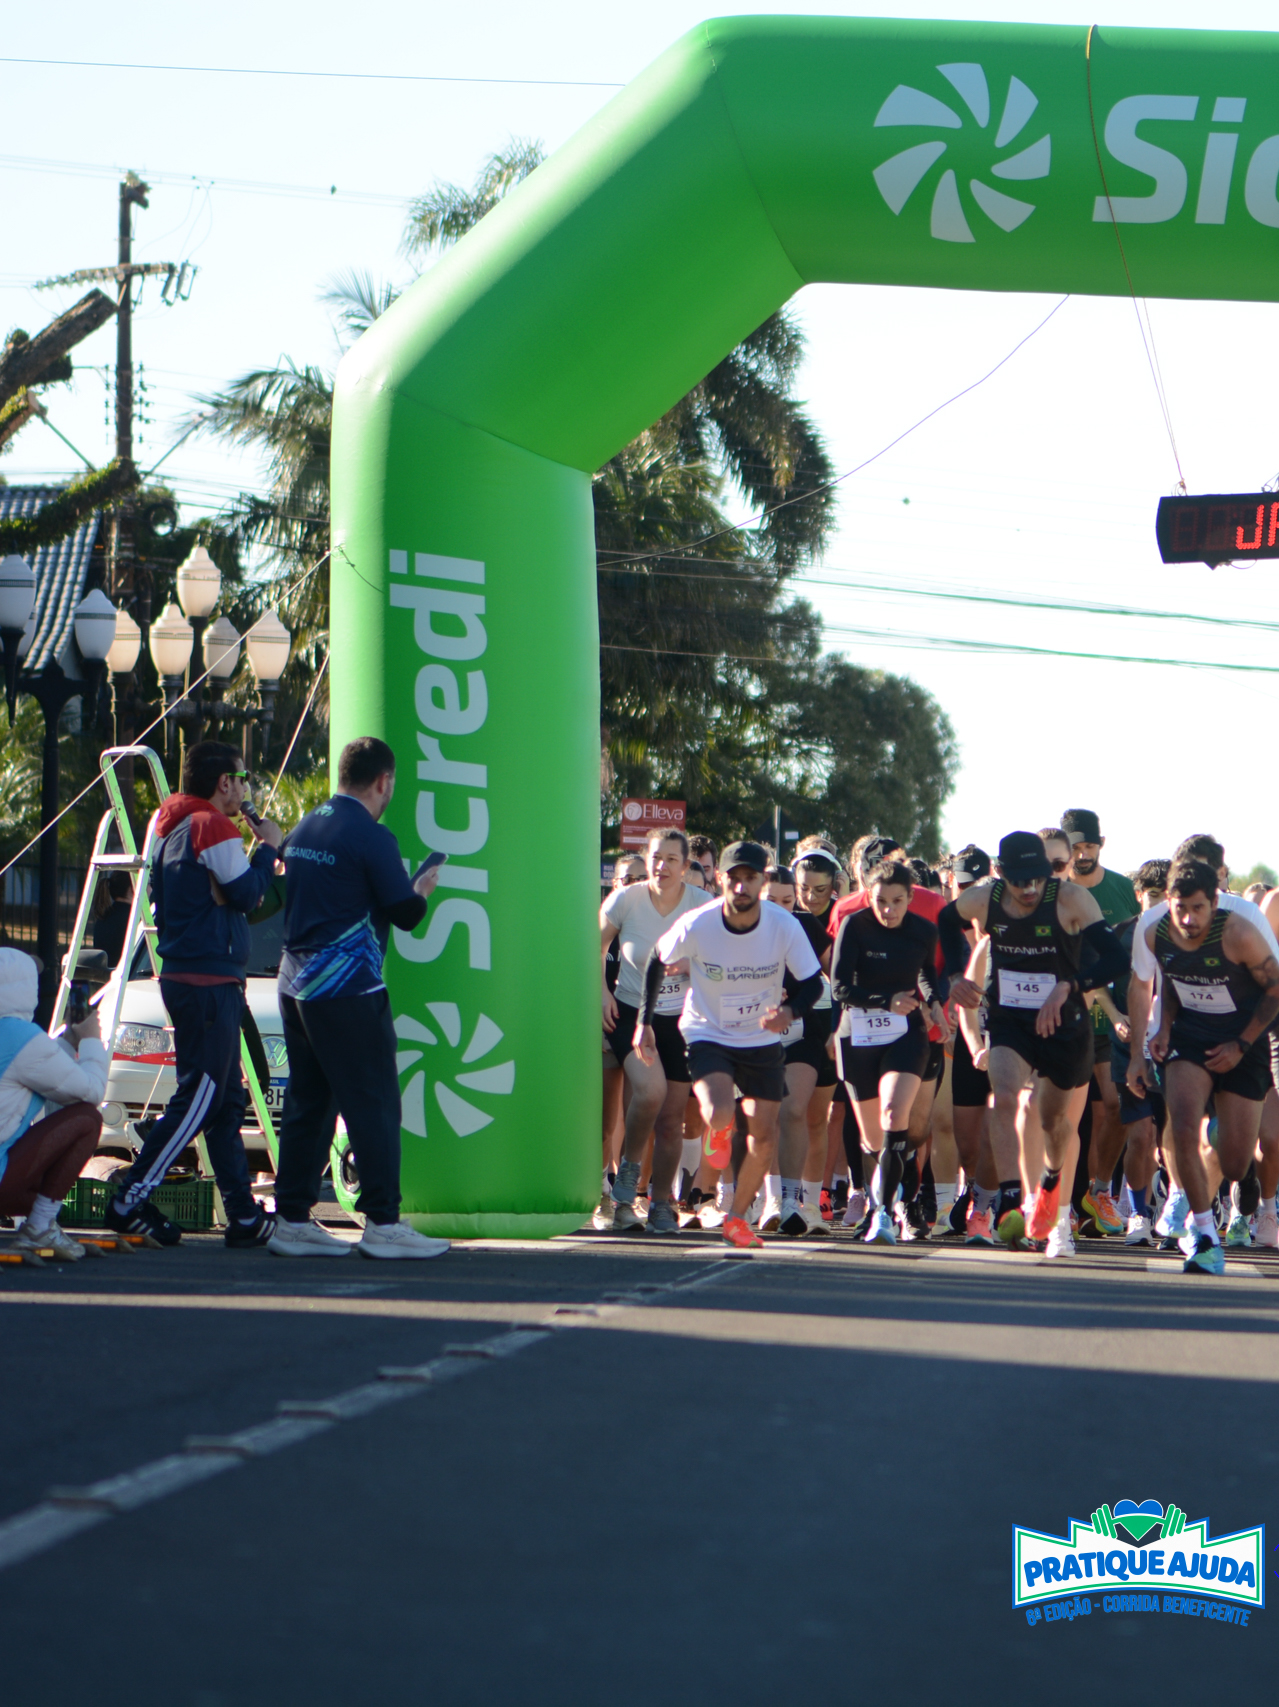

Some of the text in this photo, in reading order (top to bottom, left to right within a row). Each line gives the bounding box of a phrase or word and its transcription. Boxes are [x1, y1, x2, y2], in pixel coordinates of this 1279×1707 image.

[389, 549, 492, 971] Sicredi
[643, 804, 684, 820] Elleva
[996, 944, 1057, 955] TITANIUM
[660, 984, 681, 994] 235
[1015, 983, 1040, 993] 145
[1190, 992, 1214, 1001] 174
[738, 1003, 761, 1015] 177
[867, 1017, 891, 1028] 135
